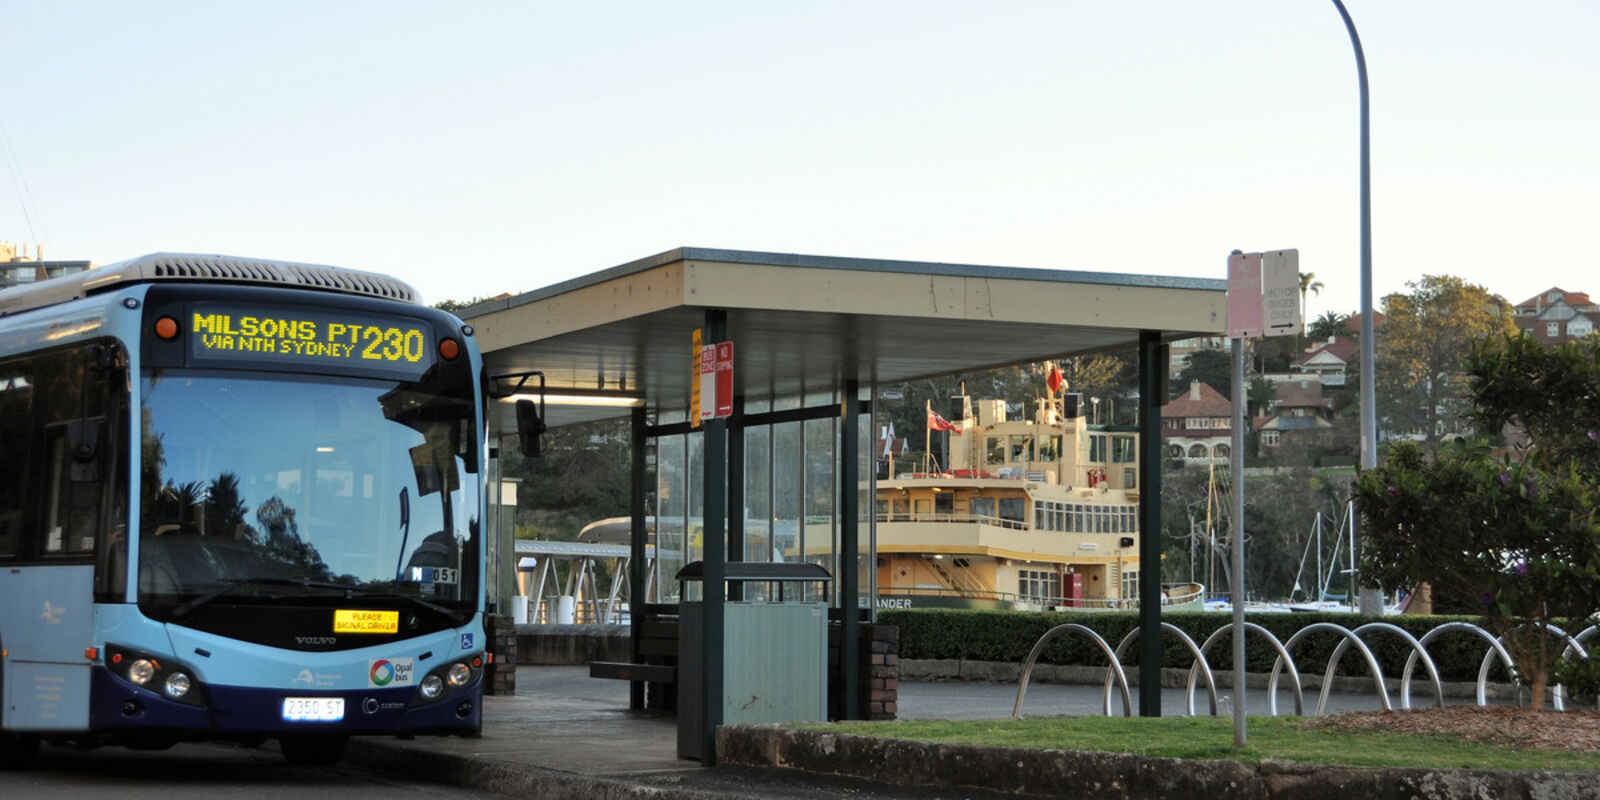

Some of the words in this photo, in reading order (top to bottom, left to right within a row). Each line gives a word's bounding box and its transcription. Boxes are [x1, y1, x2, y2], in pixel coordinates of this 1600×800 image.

[193, 313, 316, 340] MILSONS
[328, 323, 363, 343] PT
[202, 334, 235, 350] VIA
[239, 336, 275, 353] NTH
[279, 339, 356, 358] SYDNEY
[362, 327, 424, 363] 230
[703, 351, 714, 361] BUS
[432, 568, 456, 583] 051
[295, 636, 336, 644] VOLVO
[394, 663, 413, 675] Opal
[394, 673, 409, 682] bus
